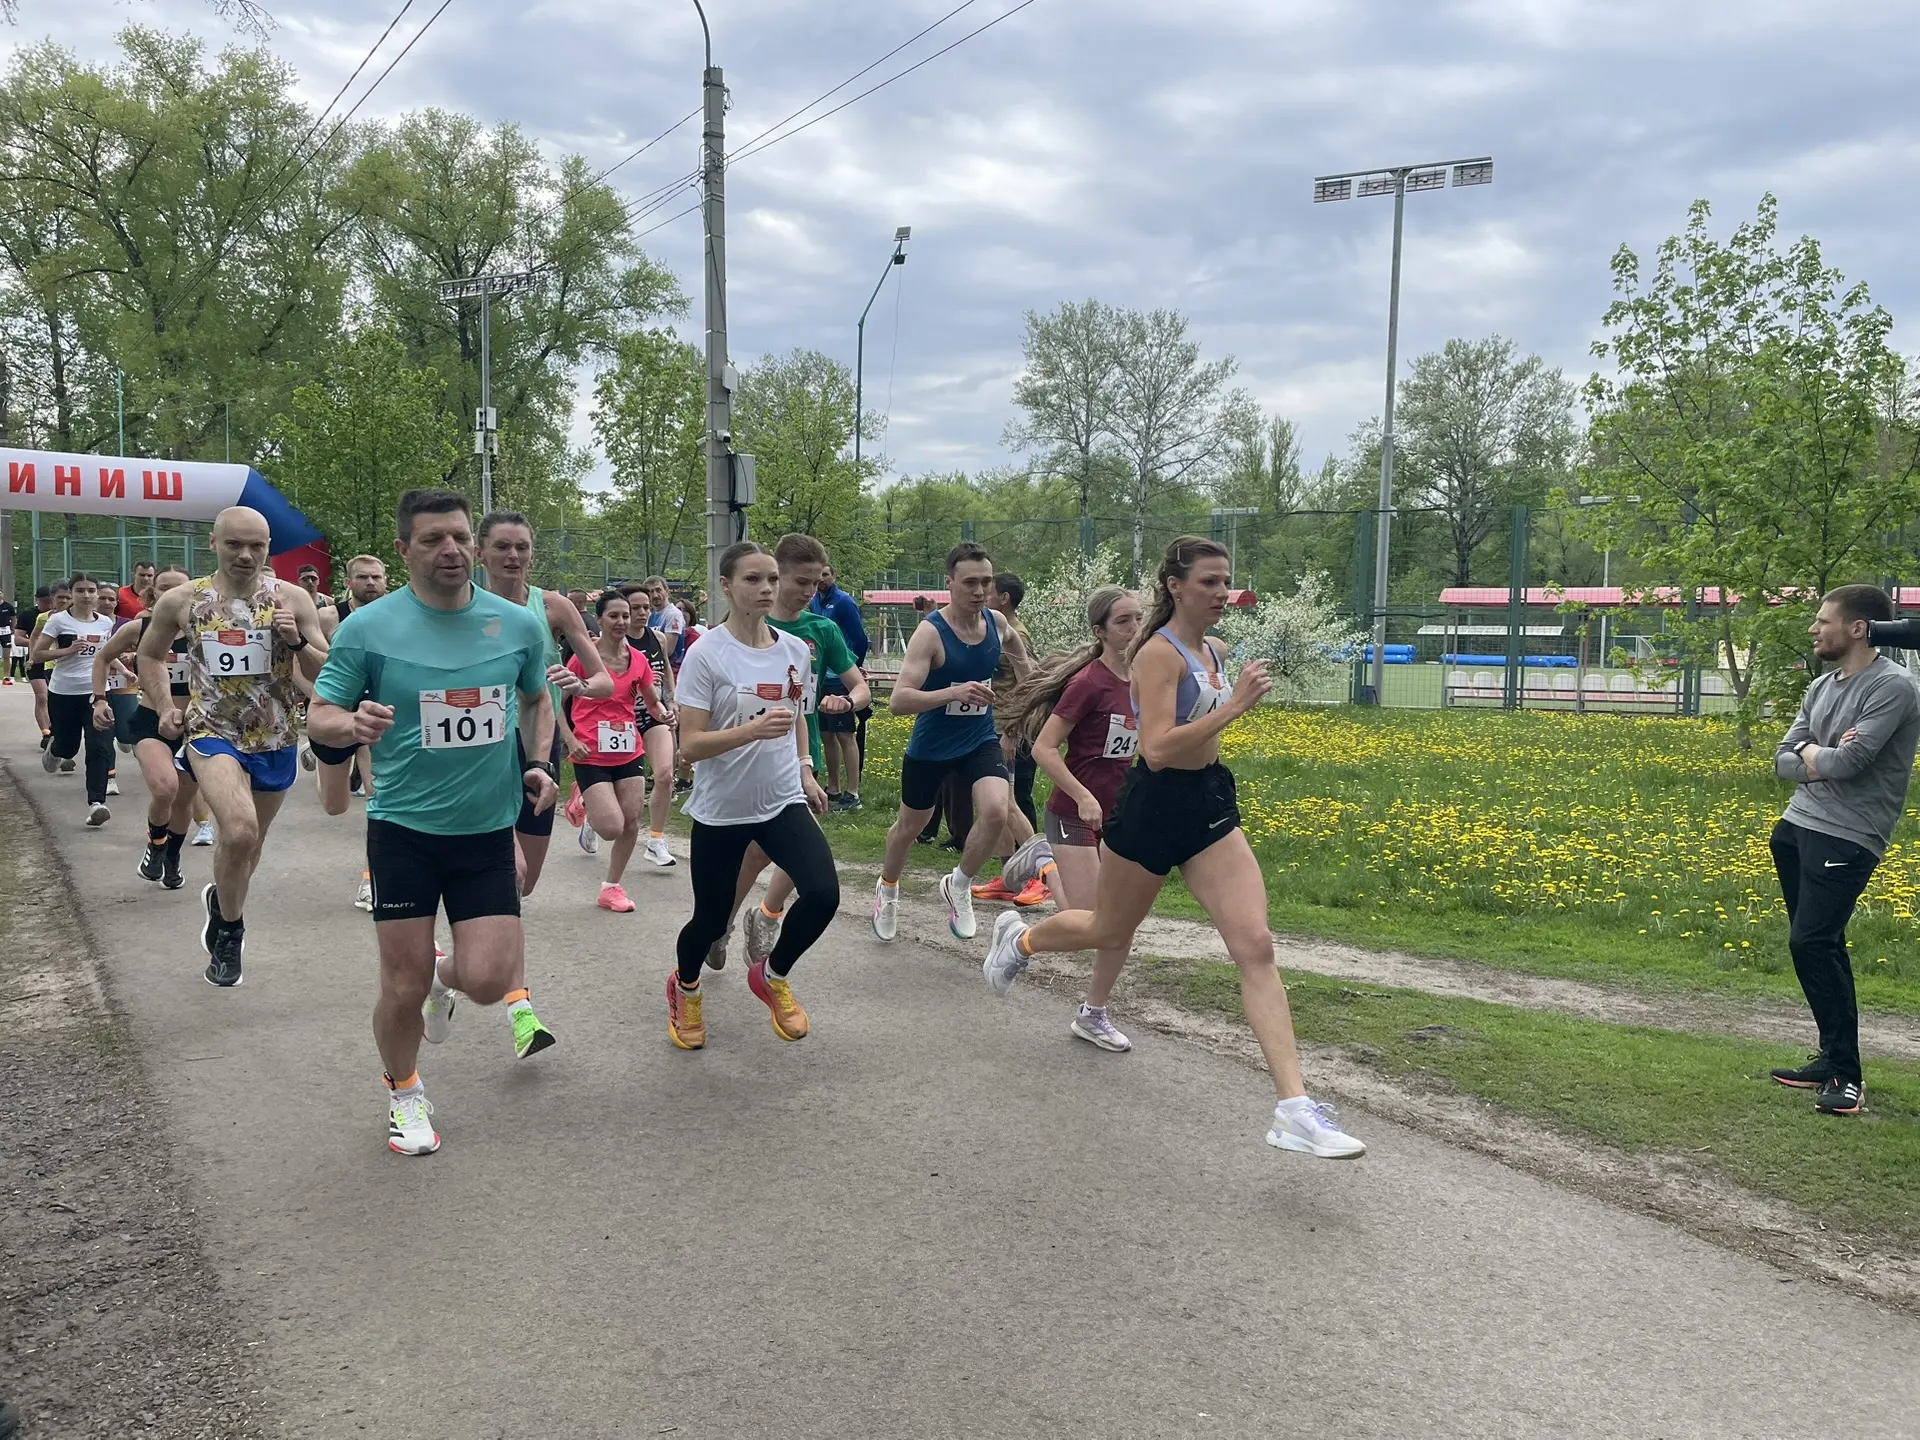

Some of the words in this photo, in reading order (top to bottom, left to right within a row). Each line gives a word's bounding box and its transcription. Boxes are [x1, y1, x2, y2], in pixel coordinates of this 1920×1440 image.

[219, 652, 250, 672] 91
[437, 716, 493, 743] 101
[609, 736, 628, 750] 31
[1110, 735, 1139, 755] 241
